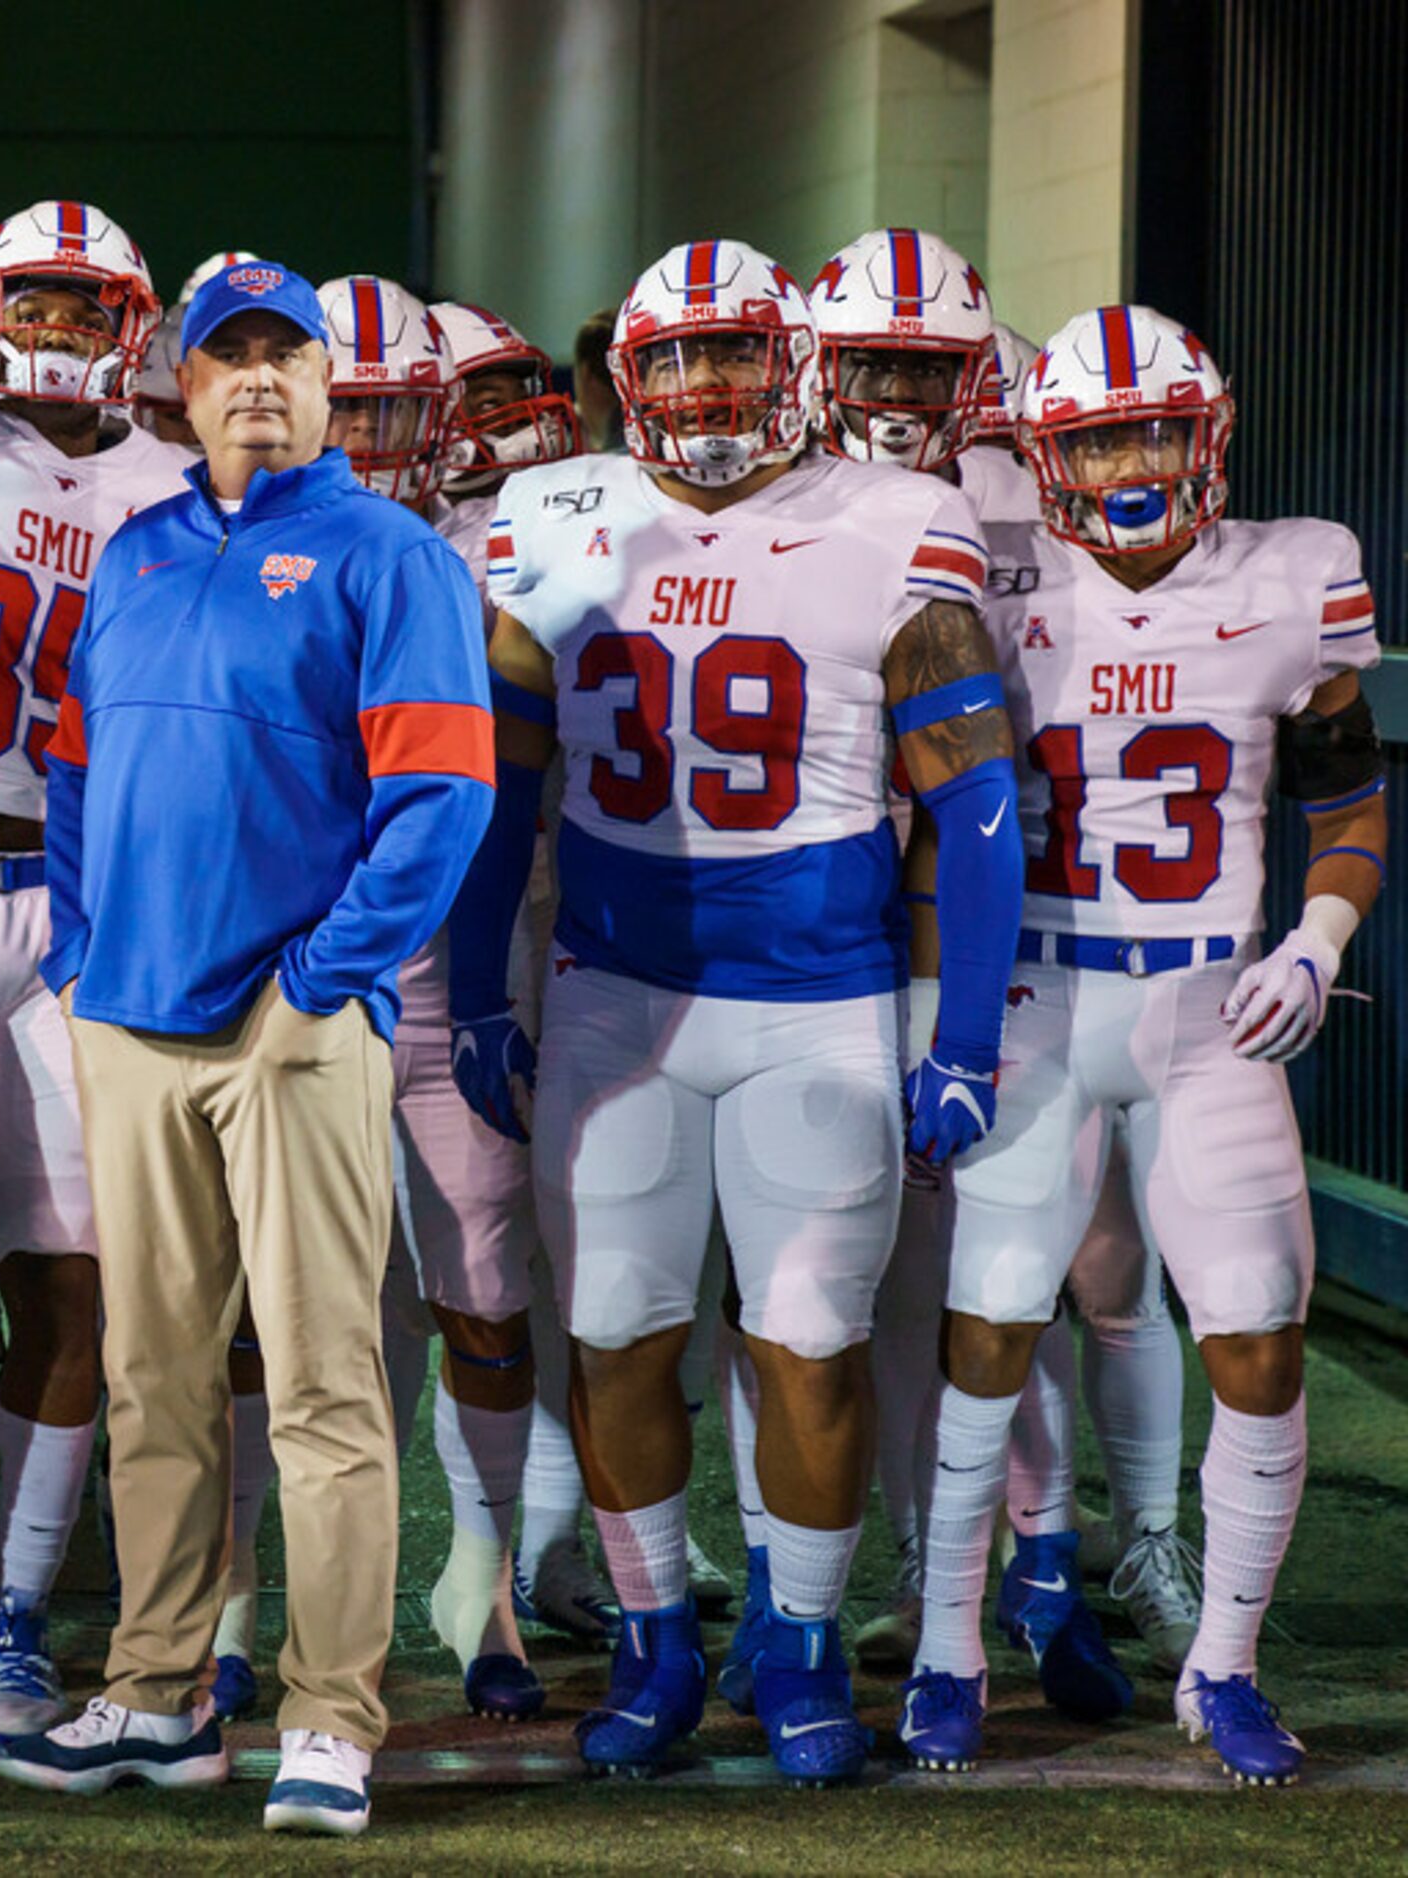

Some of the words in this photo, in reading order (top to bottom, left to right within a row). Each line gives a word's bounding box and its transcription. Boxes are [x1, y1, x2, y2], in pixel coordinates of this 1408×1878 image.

[228, 267, 283, 287] SMU
[681, 305, 719, 321] SMU
[888, 319, 924, 334] SMU
[353, 365, 388, 379] SMU
[1104, 389, 1142, 407] SMU
[543, 486, 604, 523] 150
[15, 508, 94, 580] SMU
[259, 553, 318, 582] SMU
[988, 566, 1040, 598] 50
[649, 575, 737, 627] SMU
[1089, 663, 1176, 715] SMU
[573, 631, 807, 830] 39
[1023, 722, 1234, 904] 13
